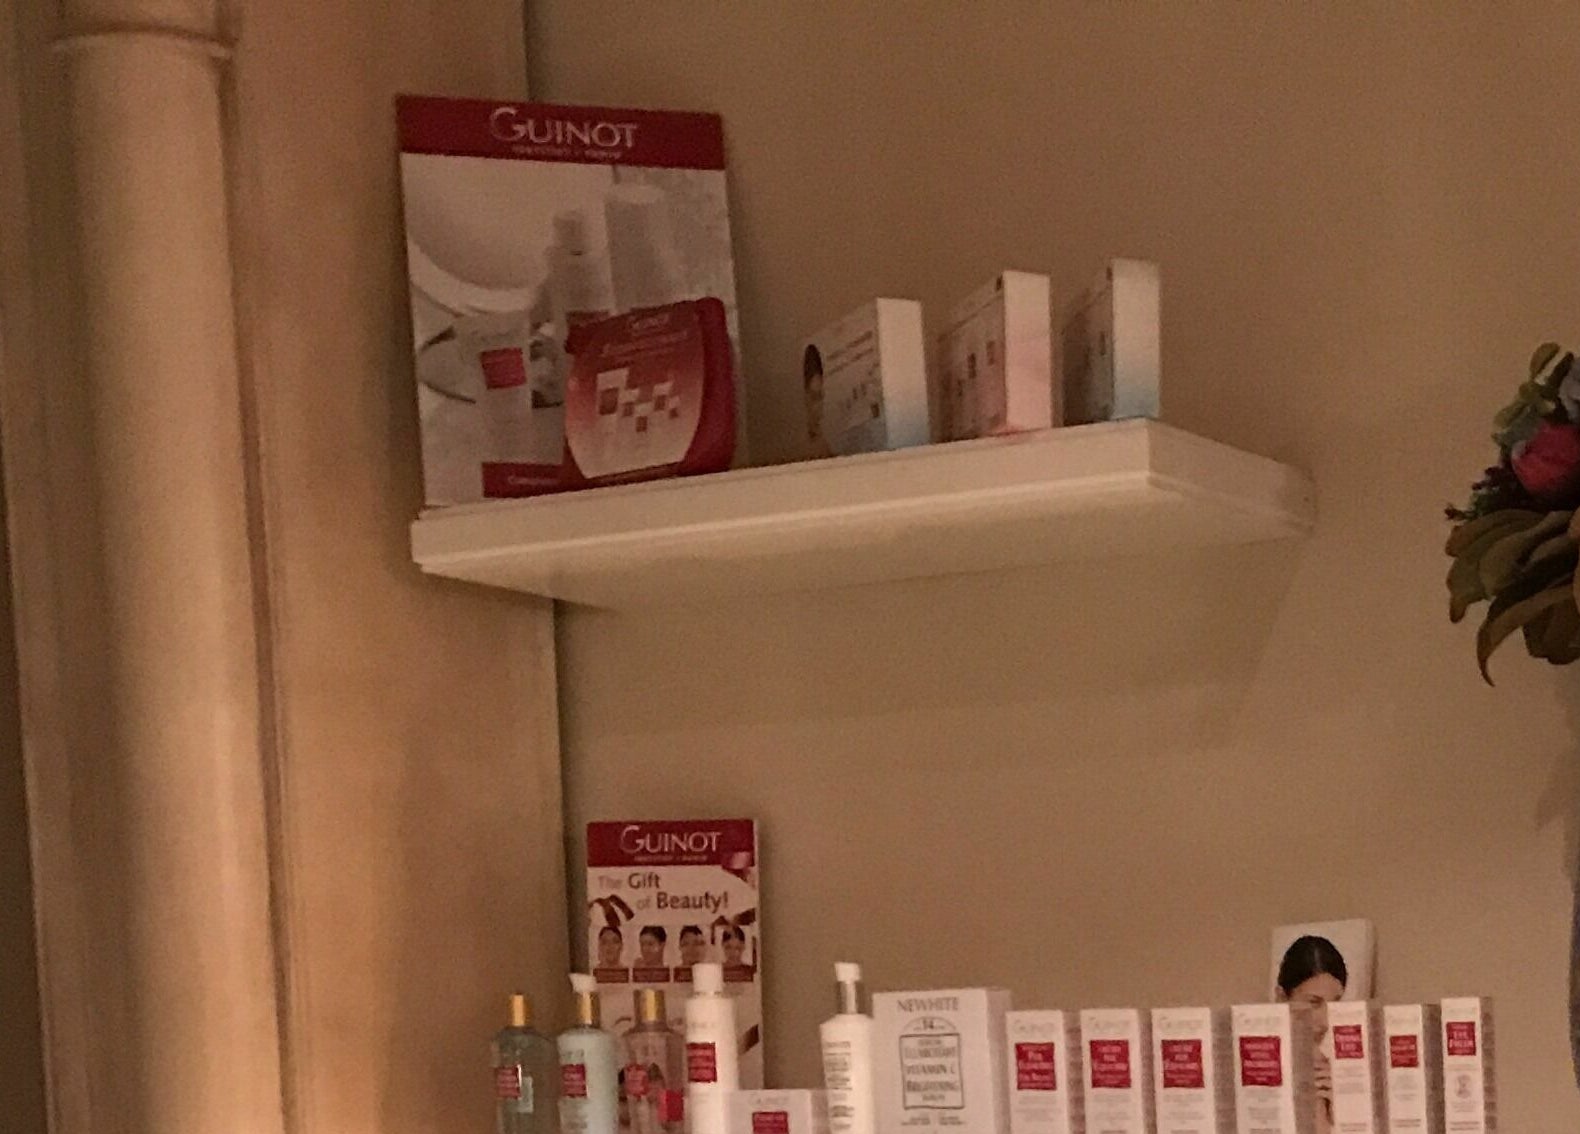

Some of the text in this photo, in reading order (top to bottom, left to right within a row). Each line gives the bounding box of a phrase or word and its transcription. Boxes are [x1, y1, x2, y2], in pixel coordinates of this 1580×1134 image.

[489, 106, 638, 148] GUINOT
[620, 825, 722, 854] GUINOT
[627, 872, 661, 890] Gift
[656, 891, 728, 914] Beauty!
